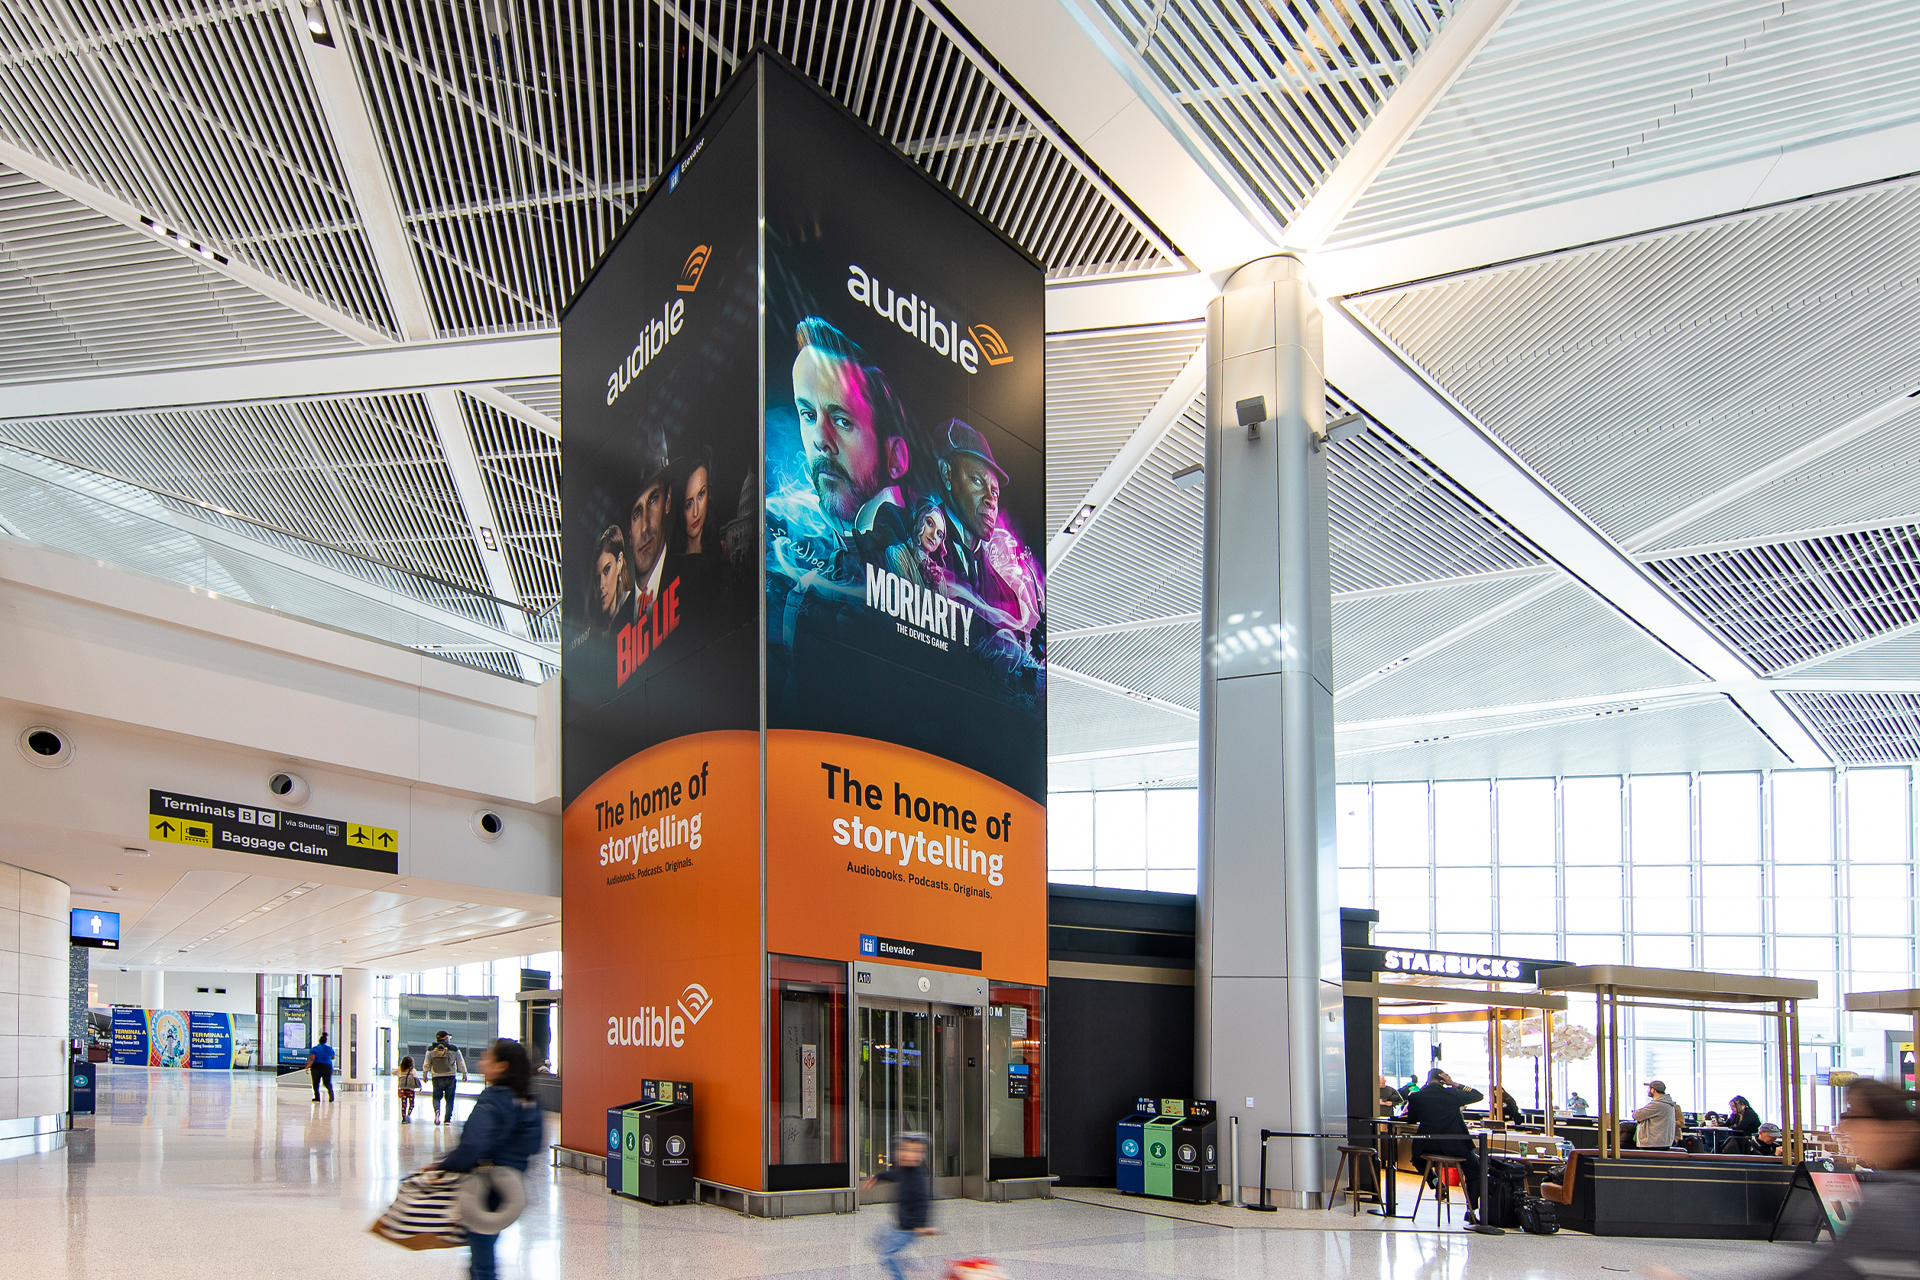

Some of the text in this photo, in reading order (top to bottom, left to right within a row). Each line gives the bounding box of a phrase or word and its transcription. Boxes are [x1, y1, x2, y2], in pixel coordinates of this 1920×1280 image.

[681, 138, 705, 173] Elevator
[847, 264, 979, 375] audible
[606, 297, 685, 406] audible
[637, 587, 654, 617] The
[866, 562, 974, 647] MORIARTY
[617, 575, 681, 689] BIG LIE
[896, 622, 949, 652] THE DEVIL'S GAME
[161, 796, 236, 819] Terminals
[285, 819, 297, 828] via
[298, 820, 325, 832] Shuttle
[595, 761, 709, 832] The home of
[821, 762, 1012, 843] The home of
[221, 830, 328, 857] Baggage Claim
[600, 812, 702, 866] storytelling
[832, 815, 1004, 887] storytelling
[606, 857, 694, 886] Audiobooks. Podcasts. Originals.
[847, 861, 993, 899] Audiobooks. Podcasts. Originals.
[880, 942, 915, 956] Elevator
[1385, 950, 1520, 979] STARBUCKS
[858, 973, 871, 984] A10
[607, 1005, 686, 1049] audible
